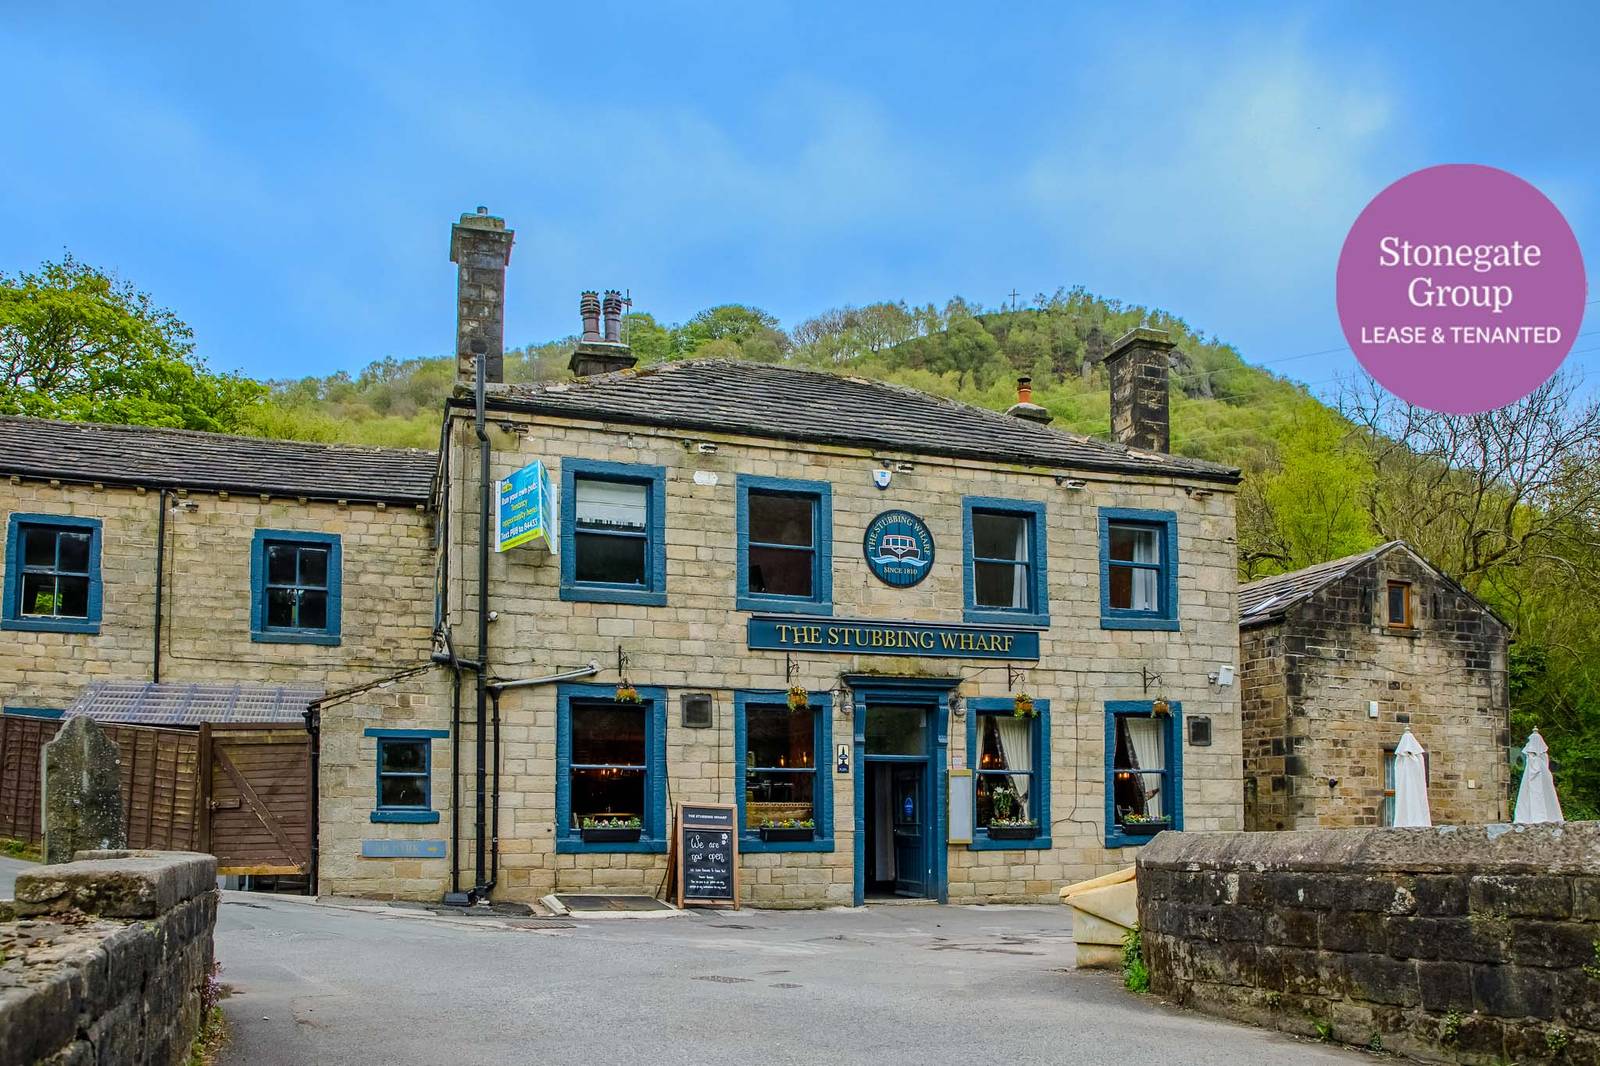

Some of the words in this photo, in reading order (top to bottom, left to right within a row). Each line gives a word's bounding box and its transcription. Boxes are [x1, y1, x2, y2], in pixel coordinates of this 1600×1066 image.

[869, 531, 878, 552] THE
[874, 515, 914, 533] STUBBING
[913, 522, 931, 556] WHARF
[884, 566, 902, 574] SINCE
[904, 567, 918, 575] 1810
[775, 624, 822, 645] THE
[827, 626, 935, 649] STUBBING
[941, 632, 1014, 652] WHARF
[690, 834, 704, 849] We
[691, 853, 703, 863] now
[708, 853, 725, 863] open
